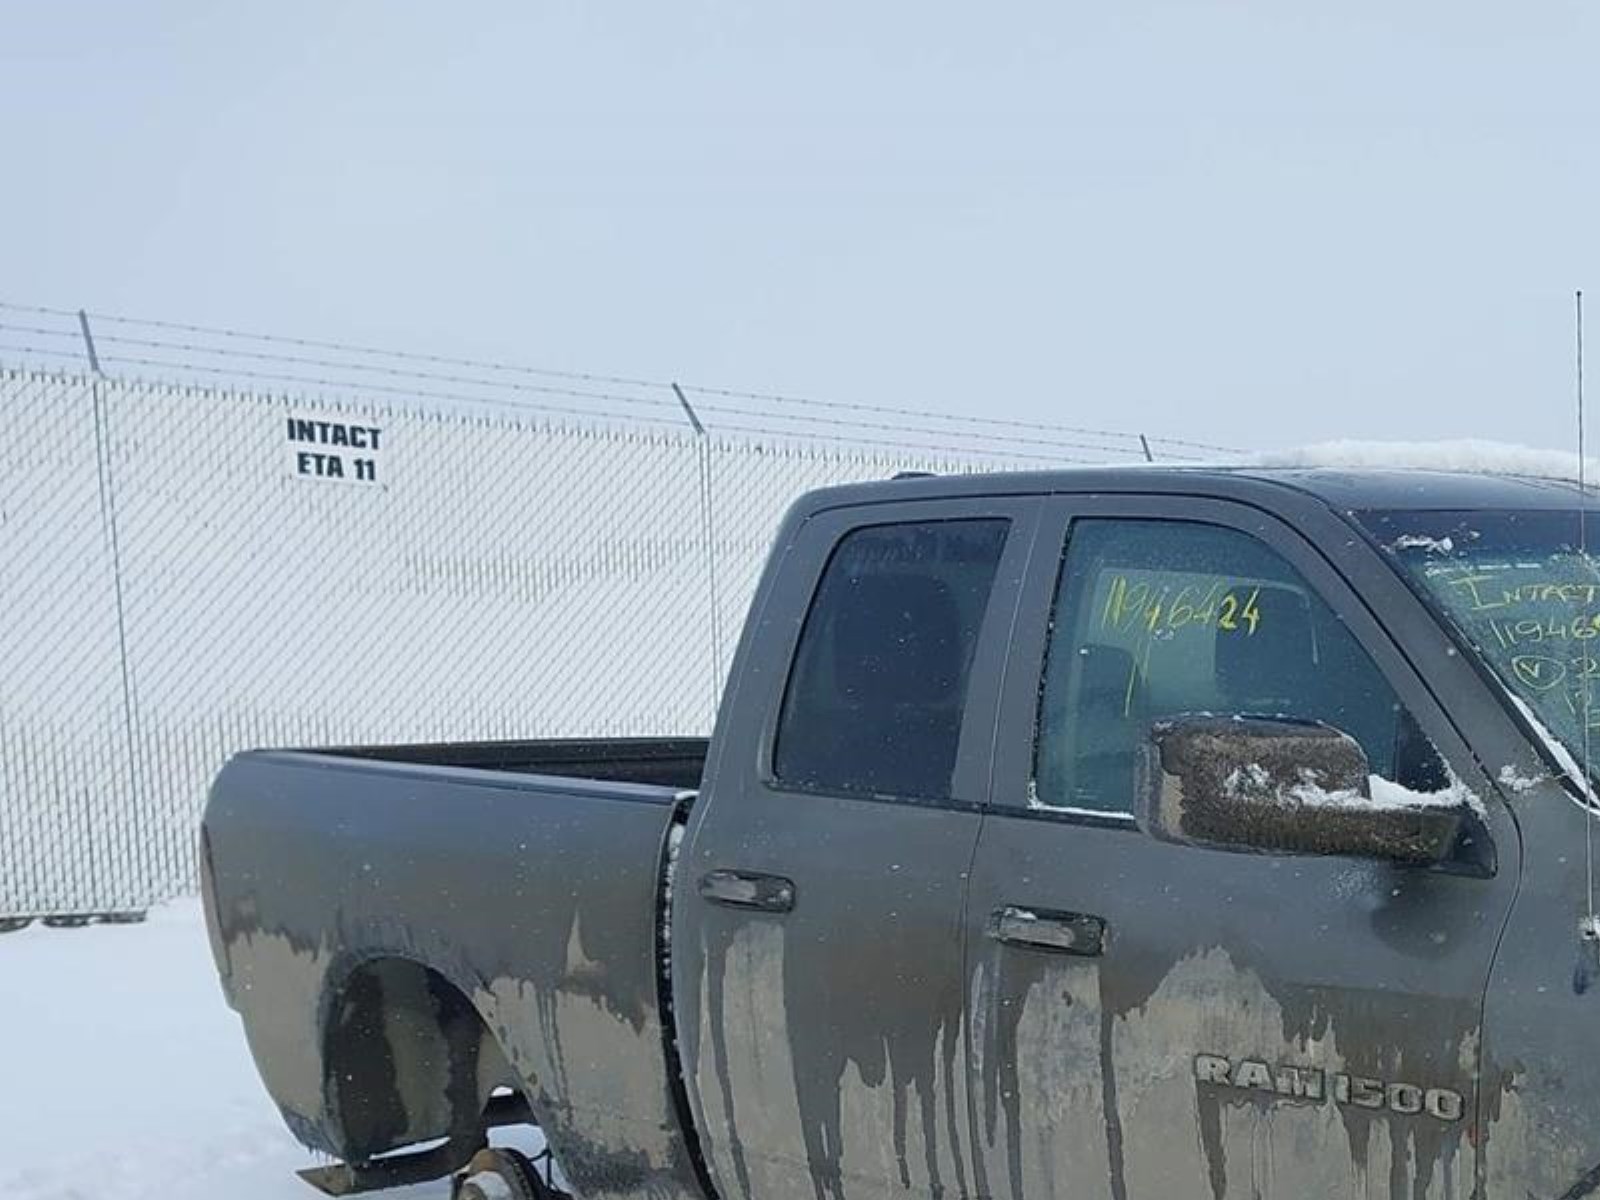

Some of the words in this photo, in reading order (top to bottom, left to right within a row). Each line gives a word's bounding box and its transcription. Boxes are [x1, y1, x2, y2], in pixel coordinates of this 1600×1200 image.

[287, 418, 381, 450] INTACT
[297, 452, 343, 478] ETA
[353, 458, 375, 481] 11
[1193, 1053, 1325, 1102] RAM
[1334, 1071, 1464, 1121] 1500
